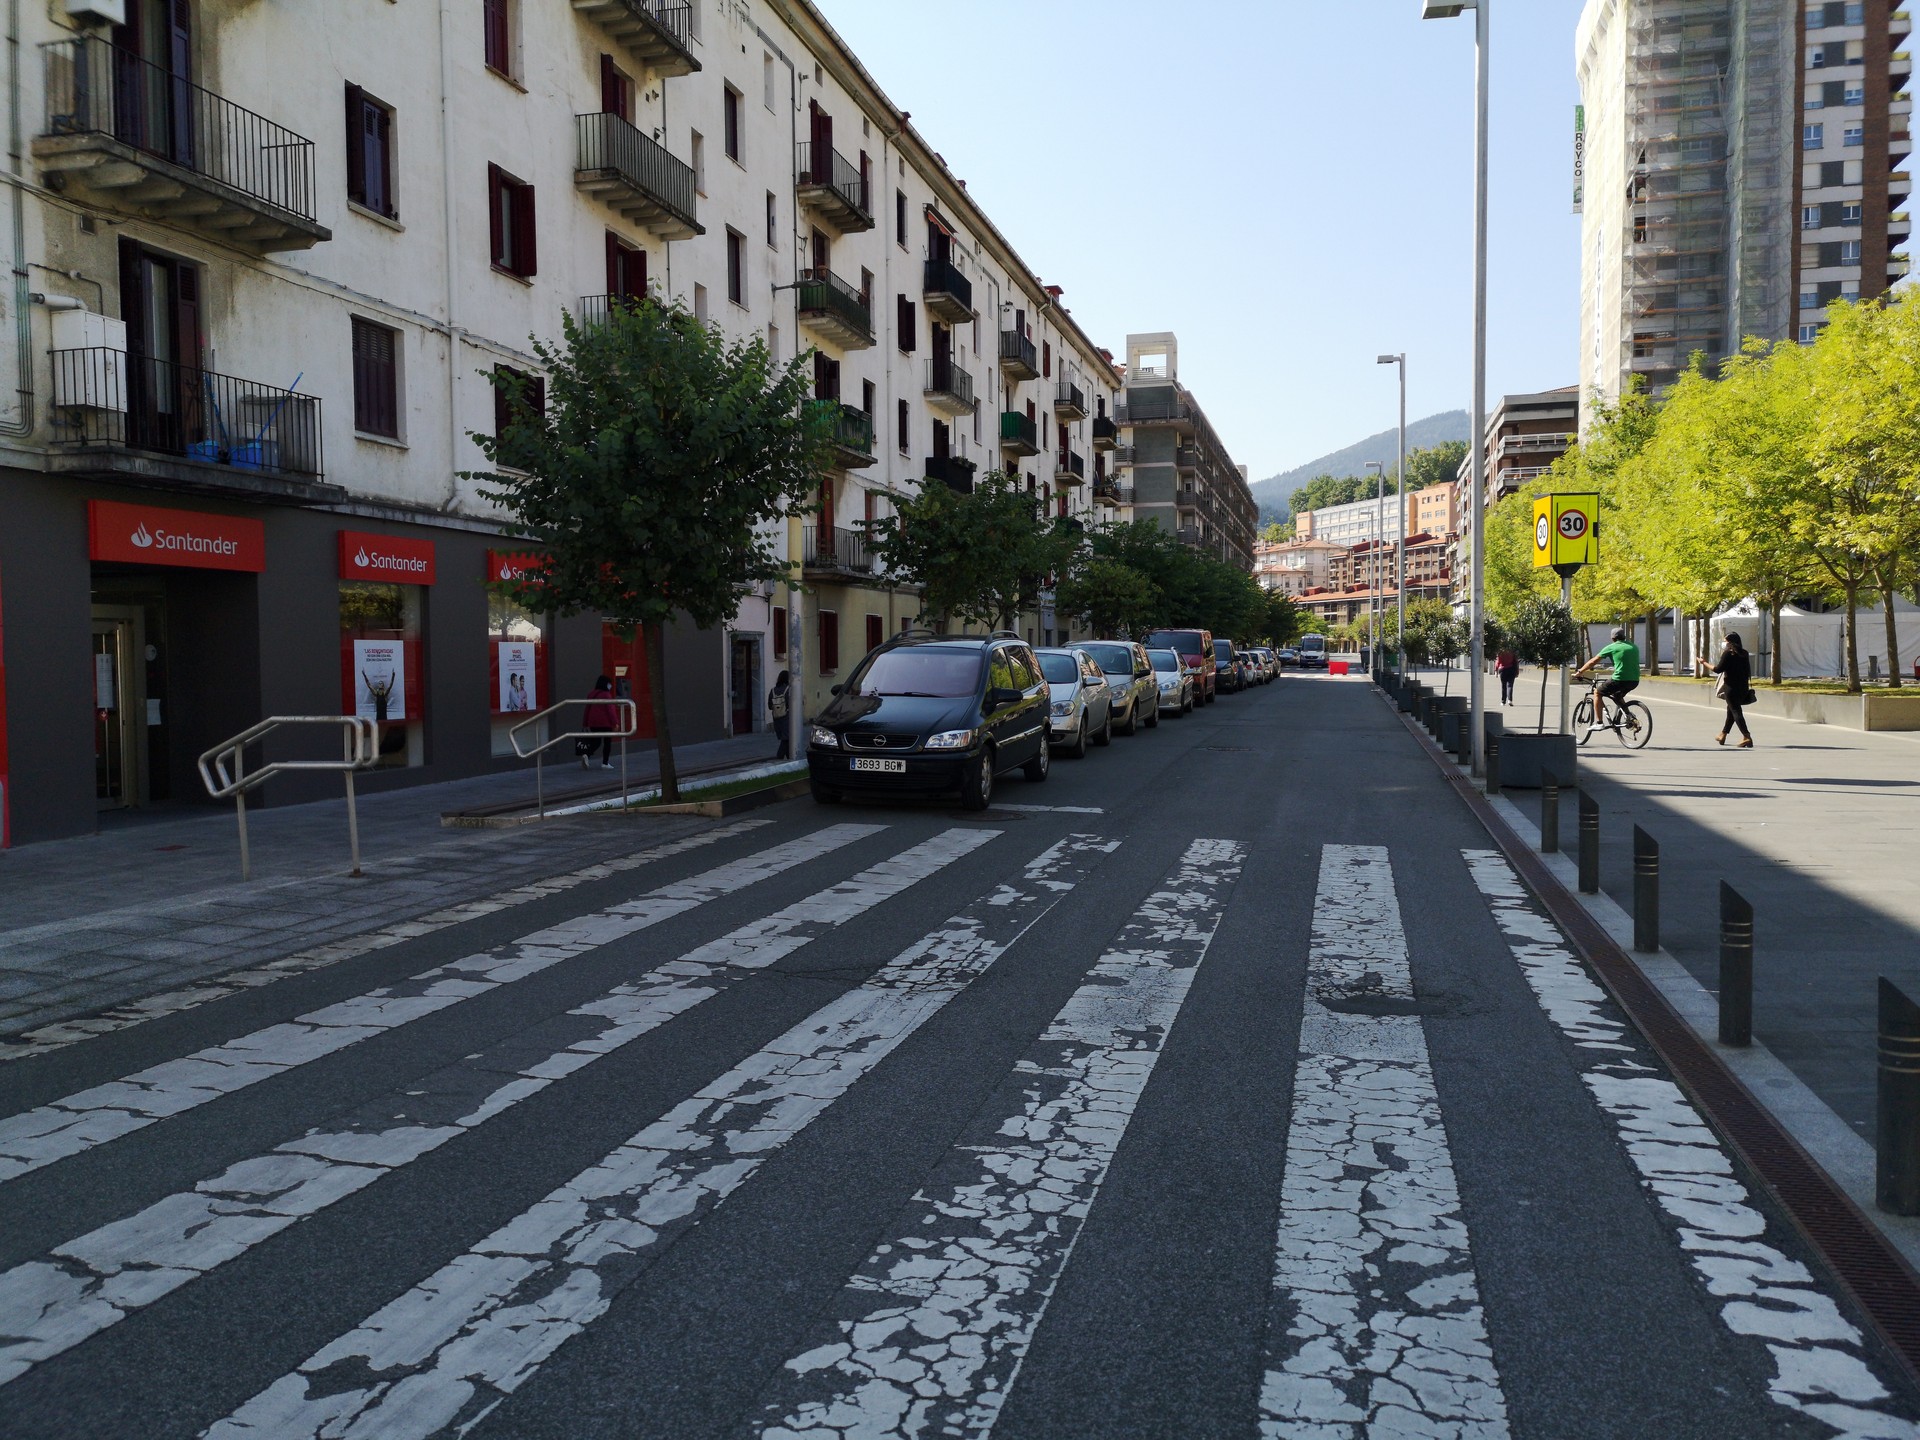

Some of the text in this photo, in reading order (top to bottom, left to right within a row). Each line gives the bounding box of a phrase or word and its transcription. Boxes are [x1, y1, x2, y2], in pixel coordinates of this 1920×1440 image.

[1538, 524, 1547, 540] 30
[1561, 517, 1584, 532] 30
[155, 529, 238, 555] Santander
[370, 551, 428, 573] Santander
[857, 759, 902, 771] 3693 BGW
